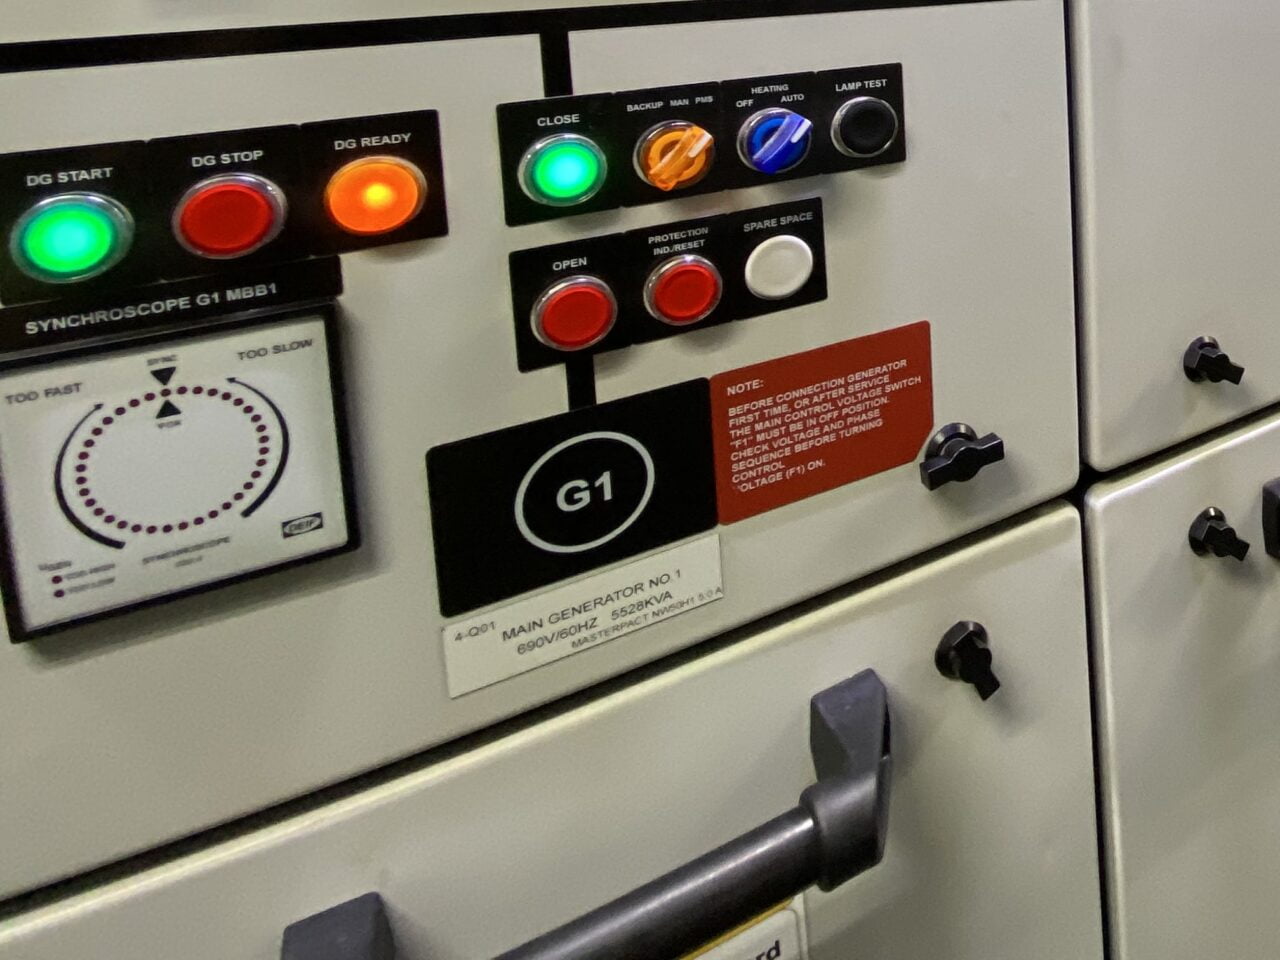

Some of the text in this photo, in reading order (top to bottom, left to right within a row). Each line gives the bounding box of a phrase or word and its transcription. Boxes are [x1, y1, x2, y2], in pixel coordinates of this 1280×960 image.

[750, 82, 790, 95] HEATING
[835, 77, 889, 93] LAMP TEST
[626, 100, 665, 113] BACKUP
[669, 98, 690, 108] MAN
[694, 95, 715, 106] PMS
[736, 98, 755, 109] OFF
[780, 92, 806, 104] AUTO
[536, 113, 581, 128] CLOSE
[333, 132, 412, 151] DG READY
[191, 149, 265, 168] DG STOP
[26, 166, 114, 187] DG START
[743, 210, 815, 233] SPARE SPACE
[648, 226, 710, 245] PROTECTION
[552, 256, 588, 272] OPEN
[25, 282, 278, 335] SYNCHROSCOPE G1 MBB1
[237, 337, 313, 361] TOO SLOW
[5, 382, 83, 406] TOO FAST
[727, 378, 765, 397] NOTE:
[728, 359, 907, 418] BEFORE CONNECTION GENERATOR
[729, 413, 760, 428] FIRST
[795, 399, 810, 410] OR
[813, 389, 845, 405] AFTER
[848, 374, 890, 394] SERVICE
[730, 375, 922, 439] THE MAIN CONTROL VOLTAGE SWITCH
[756, 428, 786, 442] MUST
[789, 421, 804, 432] BE
[806, 418, 816, 428] IN
[818, 412, 839, 425] OFF
[841, 396, 890, 418] POSITION.
[731, 409, 880, 461] CHECK VOLTAGE AND PHASE
[732, 418, 883, 473] SEQUENCE BEFORE TURNING
[732, 461, 785, 484] CONTROL
[735, 458, 826, 493] OLTAGE (F1) ON.
[556, 470, 613, 513] G1
[502, 617, 544, 642] MAIN
[548, 582, 645, 625] GENERATOR
[517, 590, 673, 656] 690V/60HZ 5528KVA
[572, 614, 647, 649] MASTERPACT
